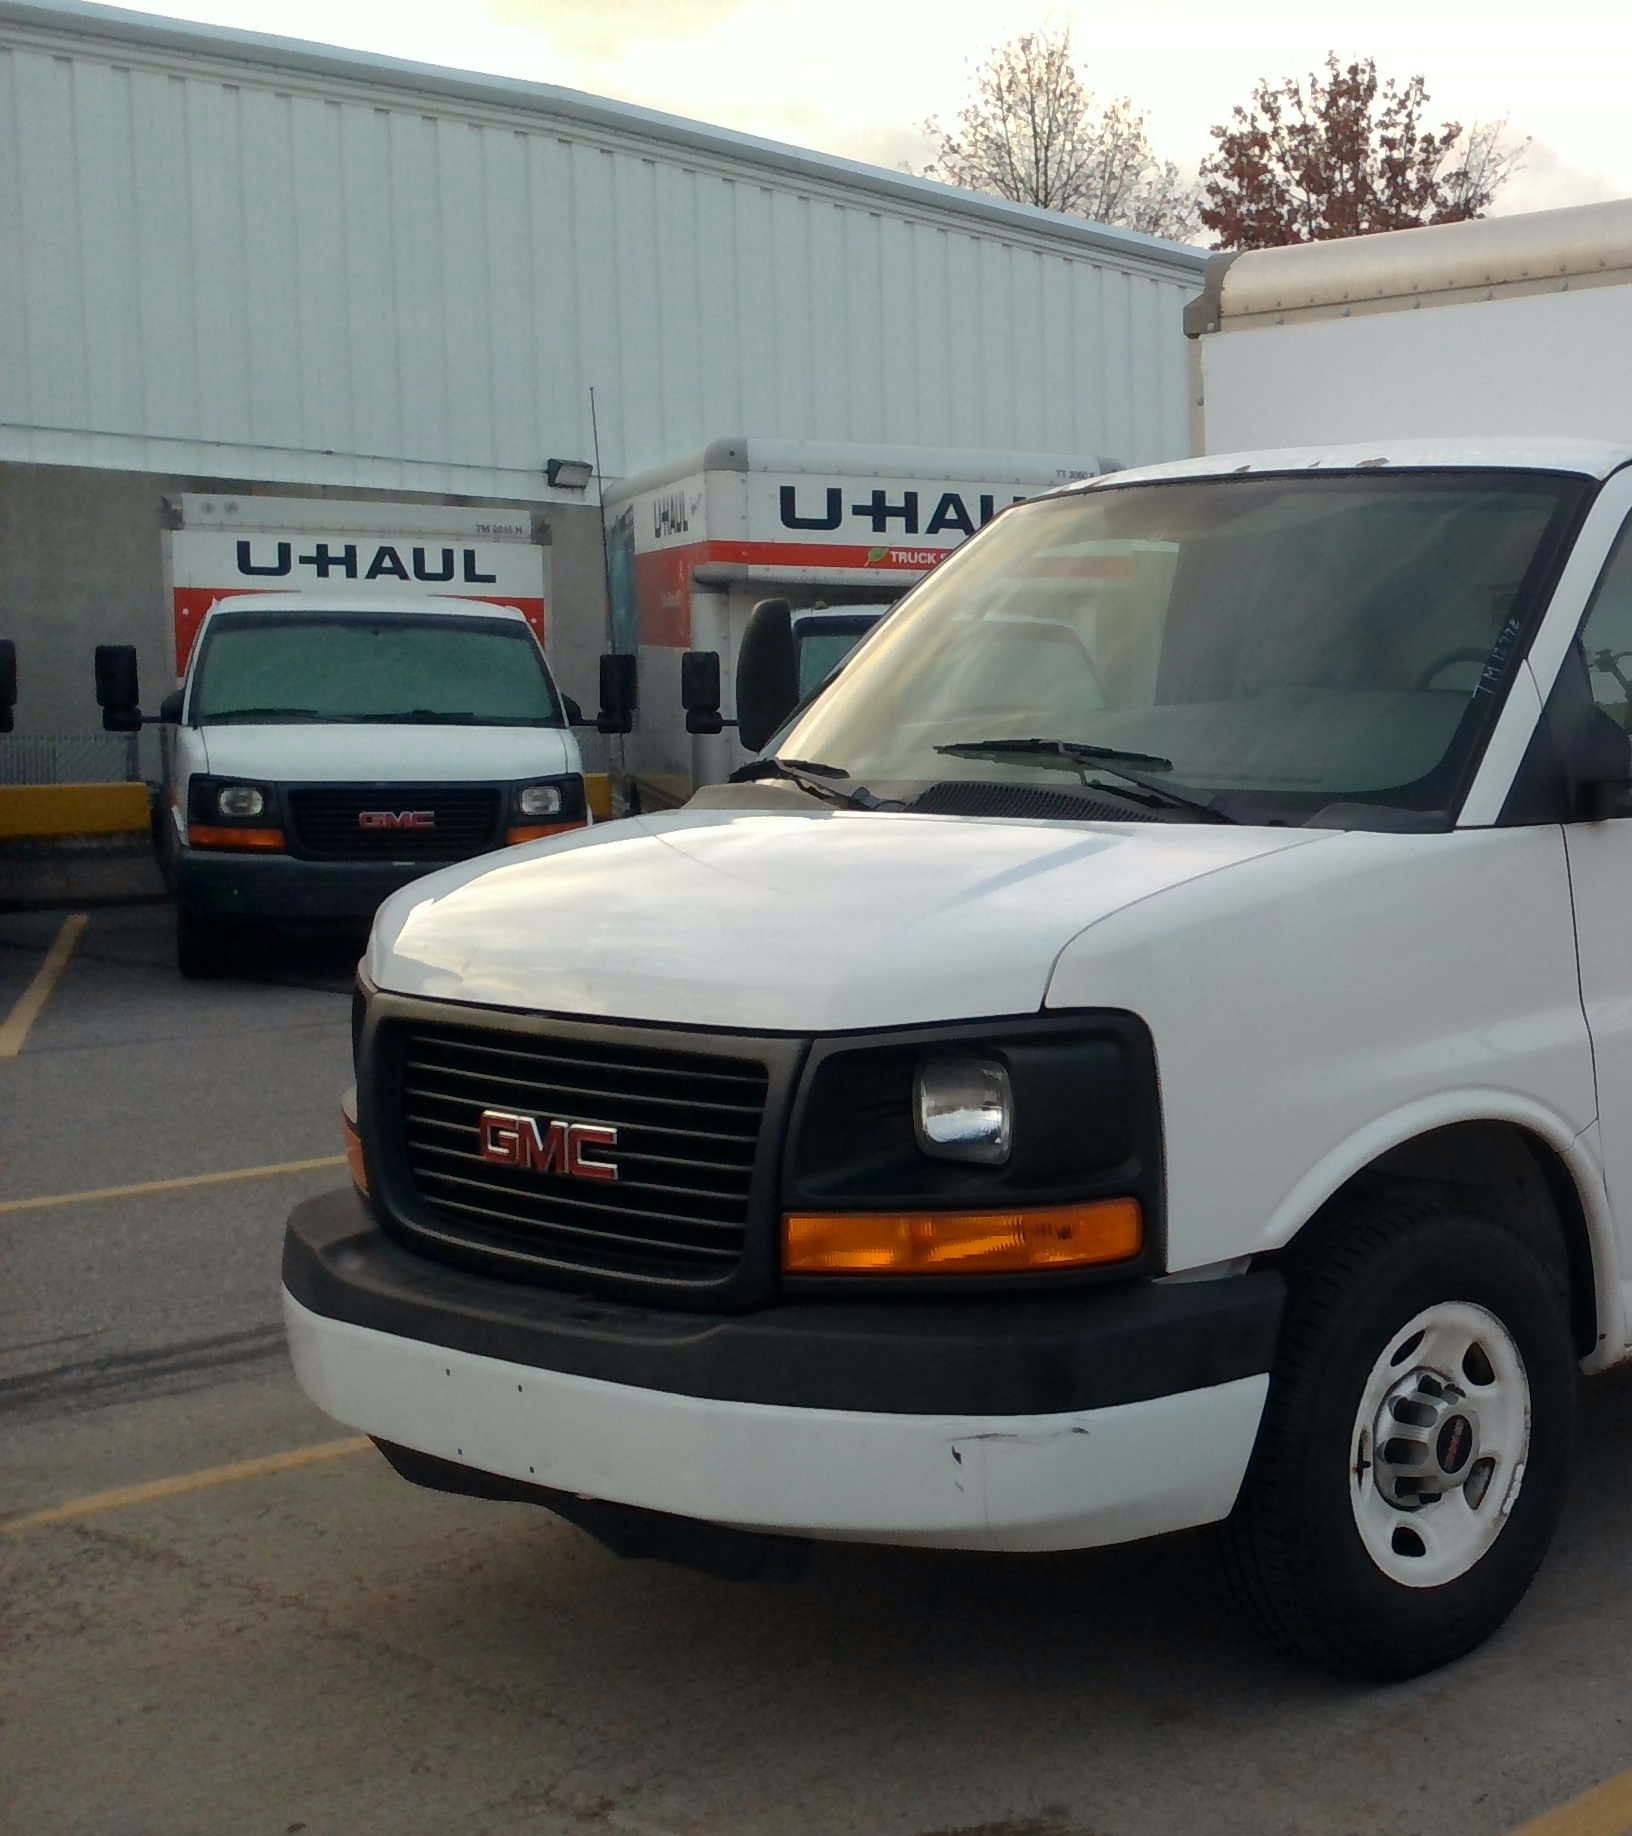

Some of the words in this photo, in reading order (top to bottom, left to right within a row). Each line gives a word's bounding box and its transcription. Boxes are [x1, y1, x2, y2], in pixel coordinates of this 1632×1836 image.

[236, 540, 497, 584] U-HAUL
[889, 550, 938, 565] TRUCK
[358, 811, 435, 829] GMC
[480, 1109, 619, 1181] GMC
